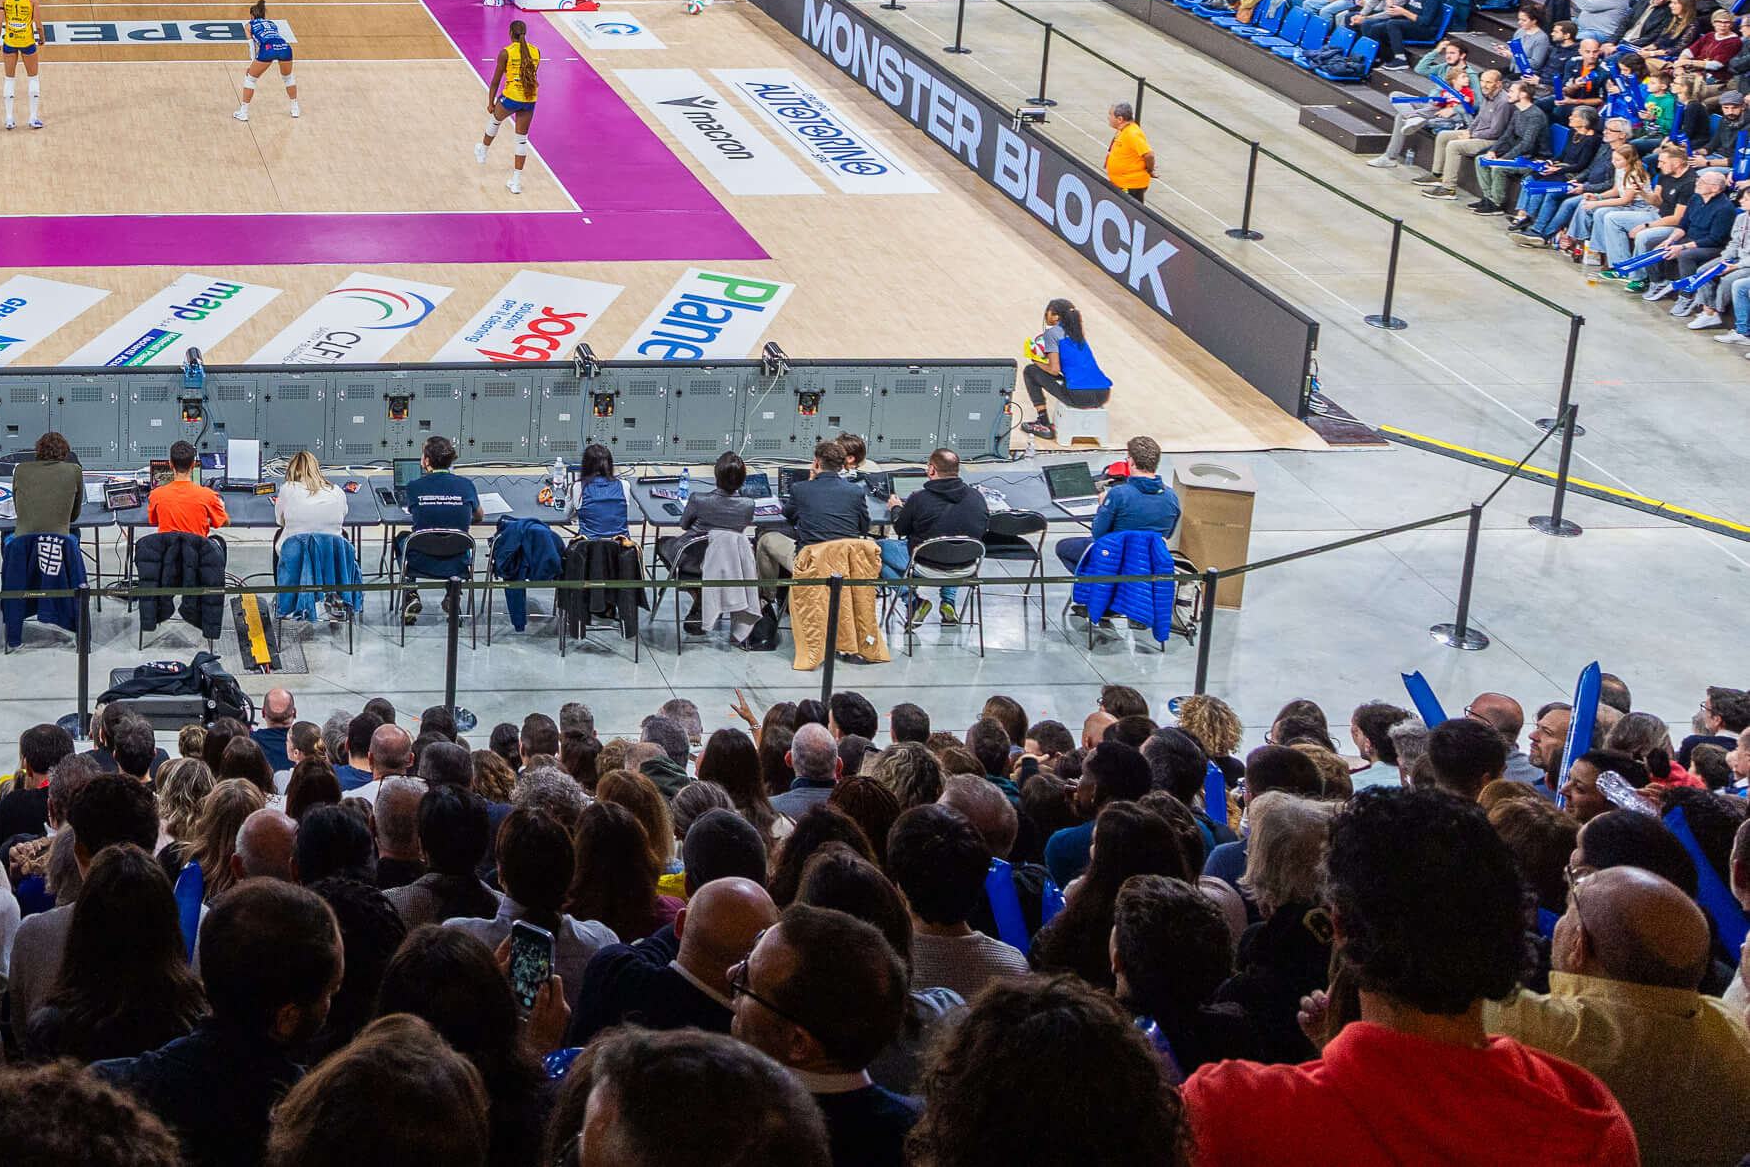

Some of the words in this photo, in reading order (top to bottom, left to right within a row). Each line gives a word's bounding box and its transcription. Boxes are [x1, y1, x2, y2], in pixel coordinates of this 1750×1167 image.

[14, 3, 19, 17] 1
[682, 111, 755, 160] macron
[745, 82, 888, 176] AUTOTORINO
[993, 133, 1179, 316] BLOCK
[168, 282, 245, 321] map
